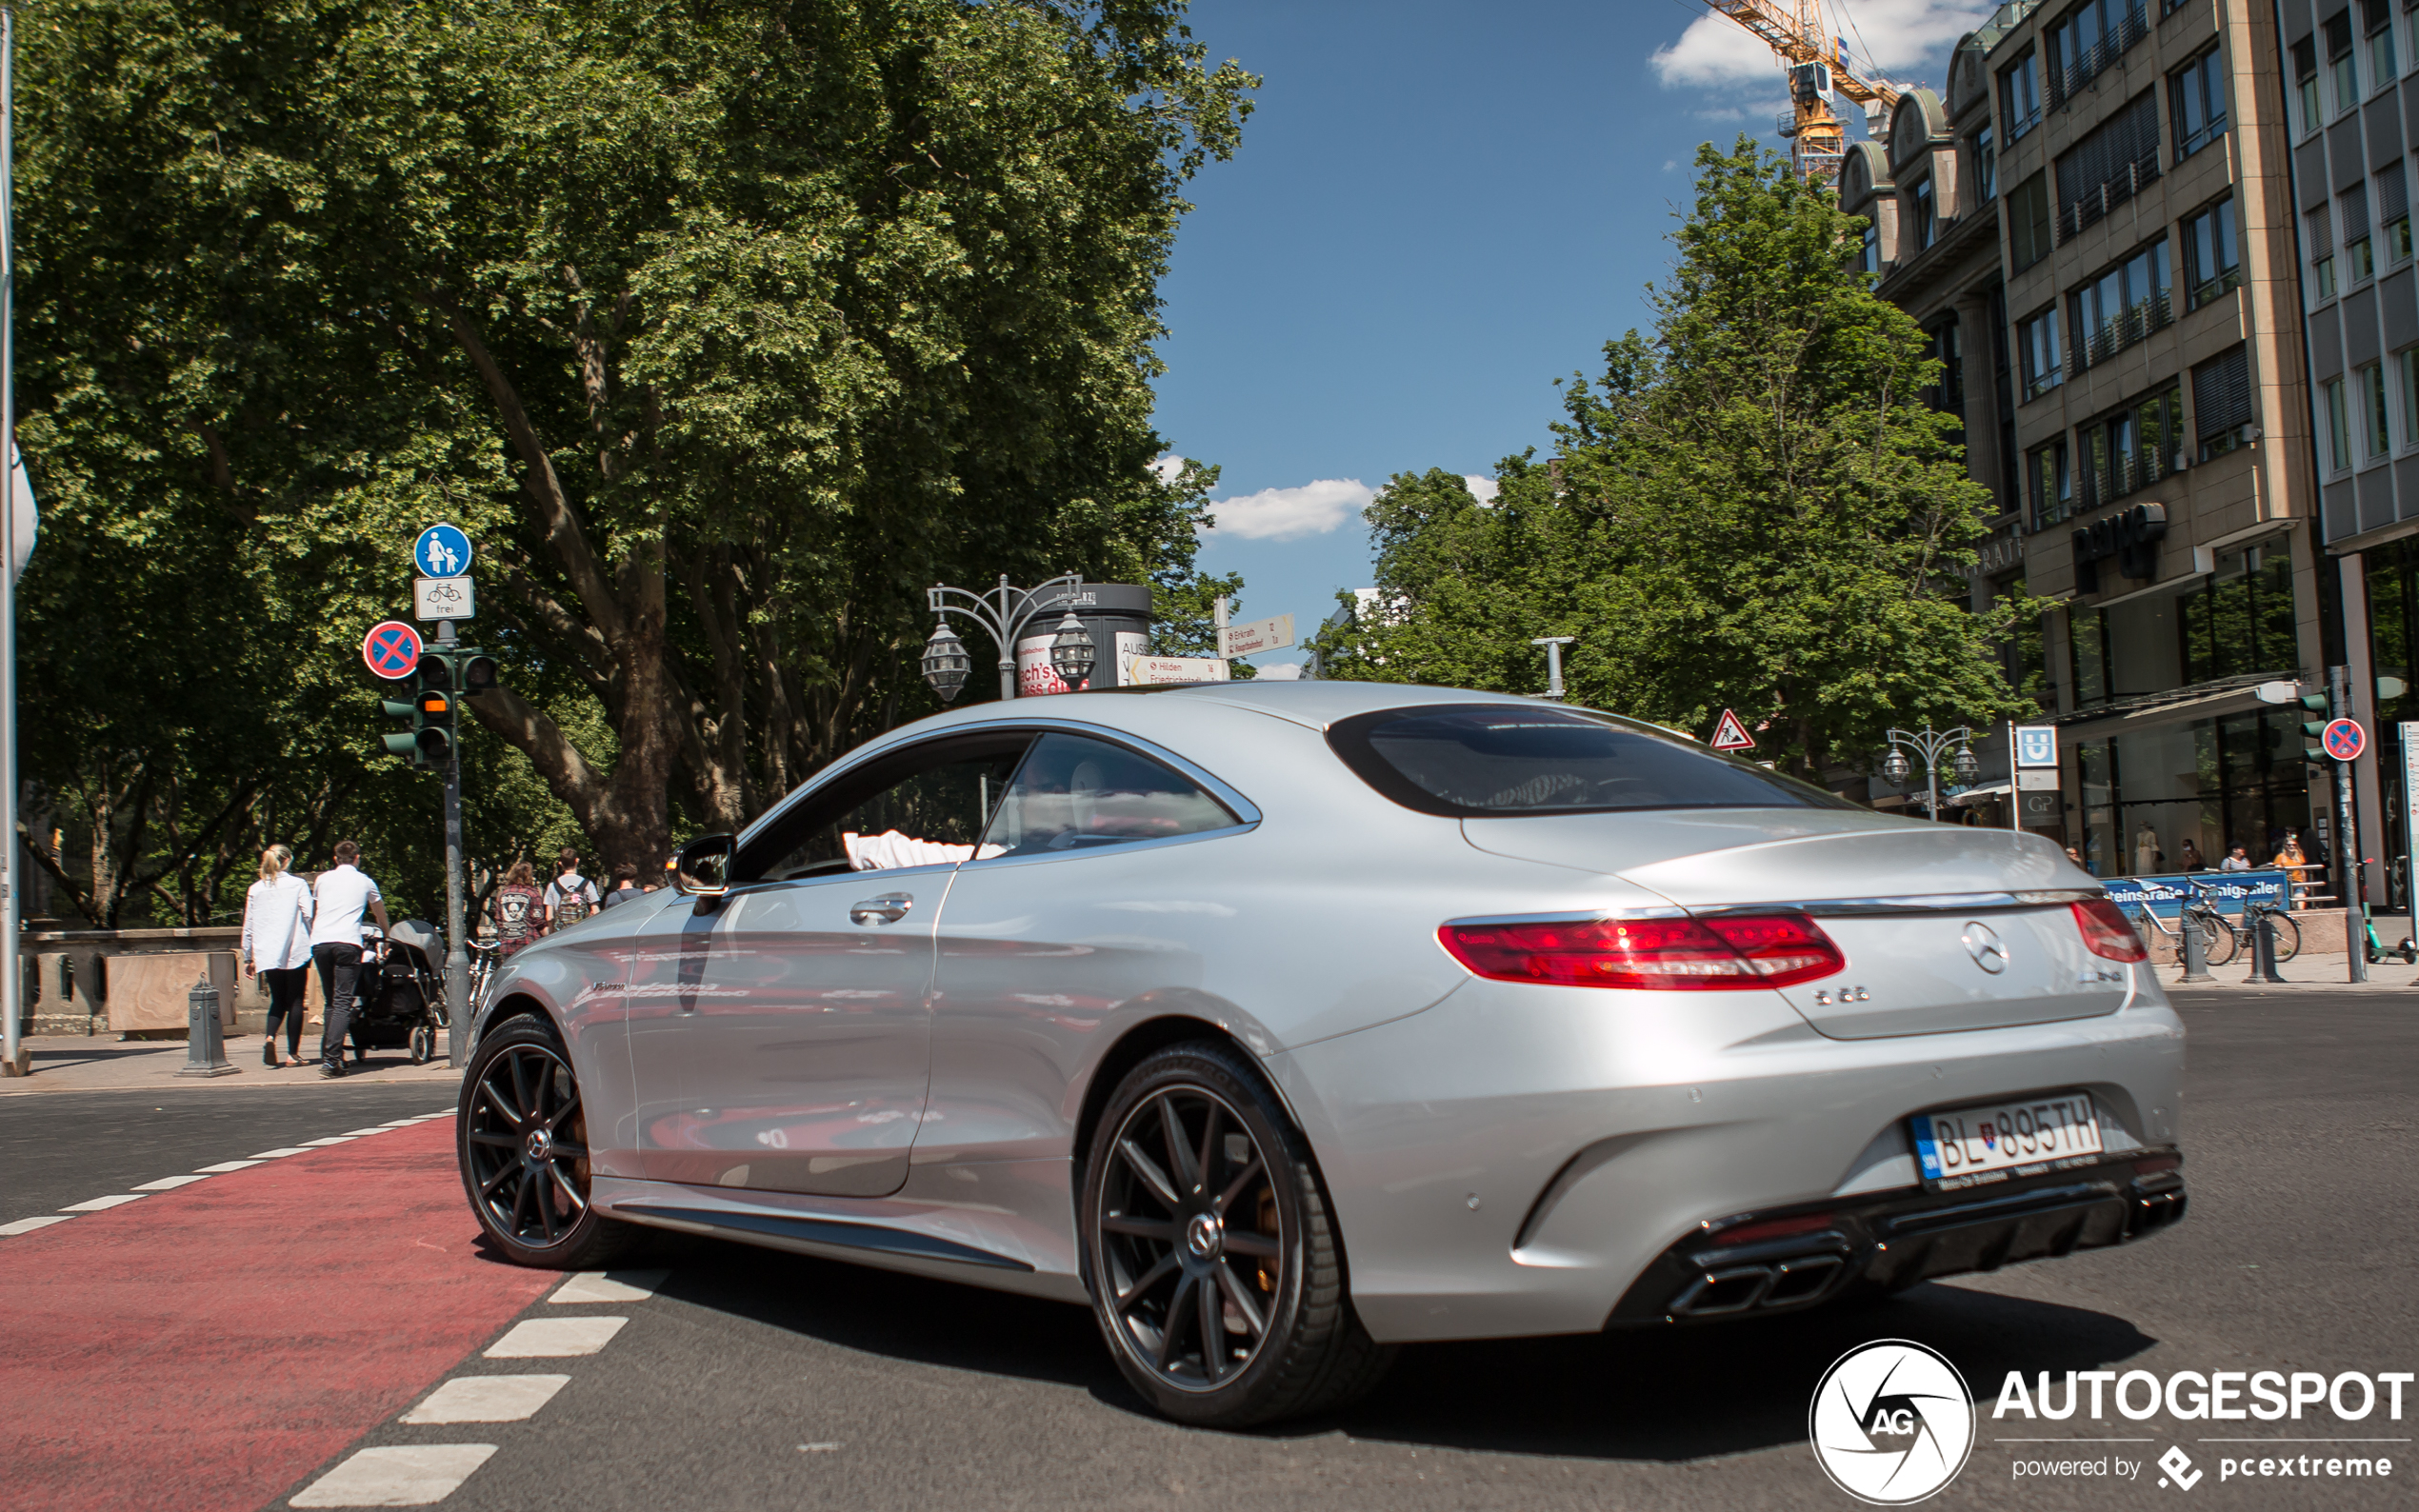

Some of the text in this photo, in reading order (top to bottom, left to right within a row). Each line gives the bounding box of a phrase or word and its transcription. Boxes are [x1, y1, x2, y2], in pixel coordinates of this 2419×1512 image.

[436, 605, 454, 613] frei
[1234, 628, 1255, 641] Erkrath
[1159, 662, 1183, 671] Hilden
[1937, 1098, 2095, 1168] BL 895TH
